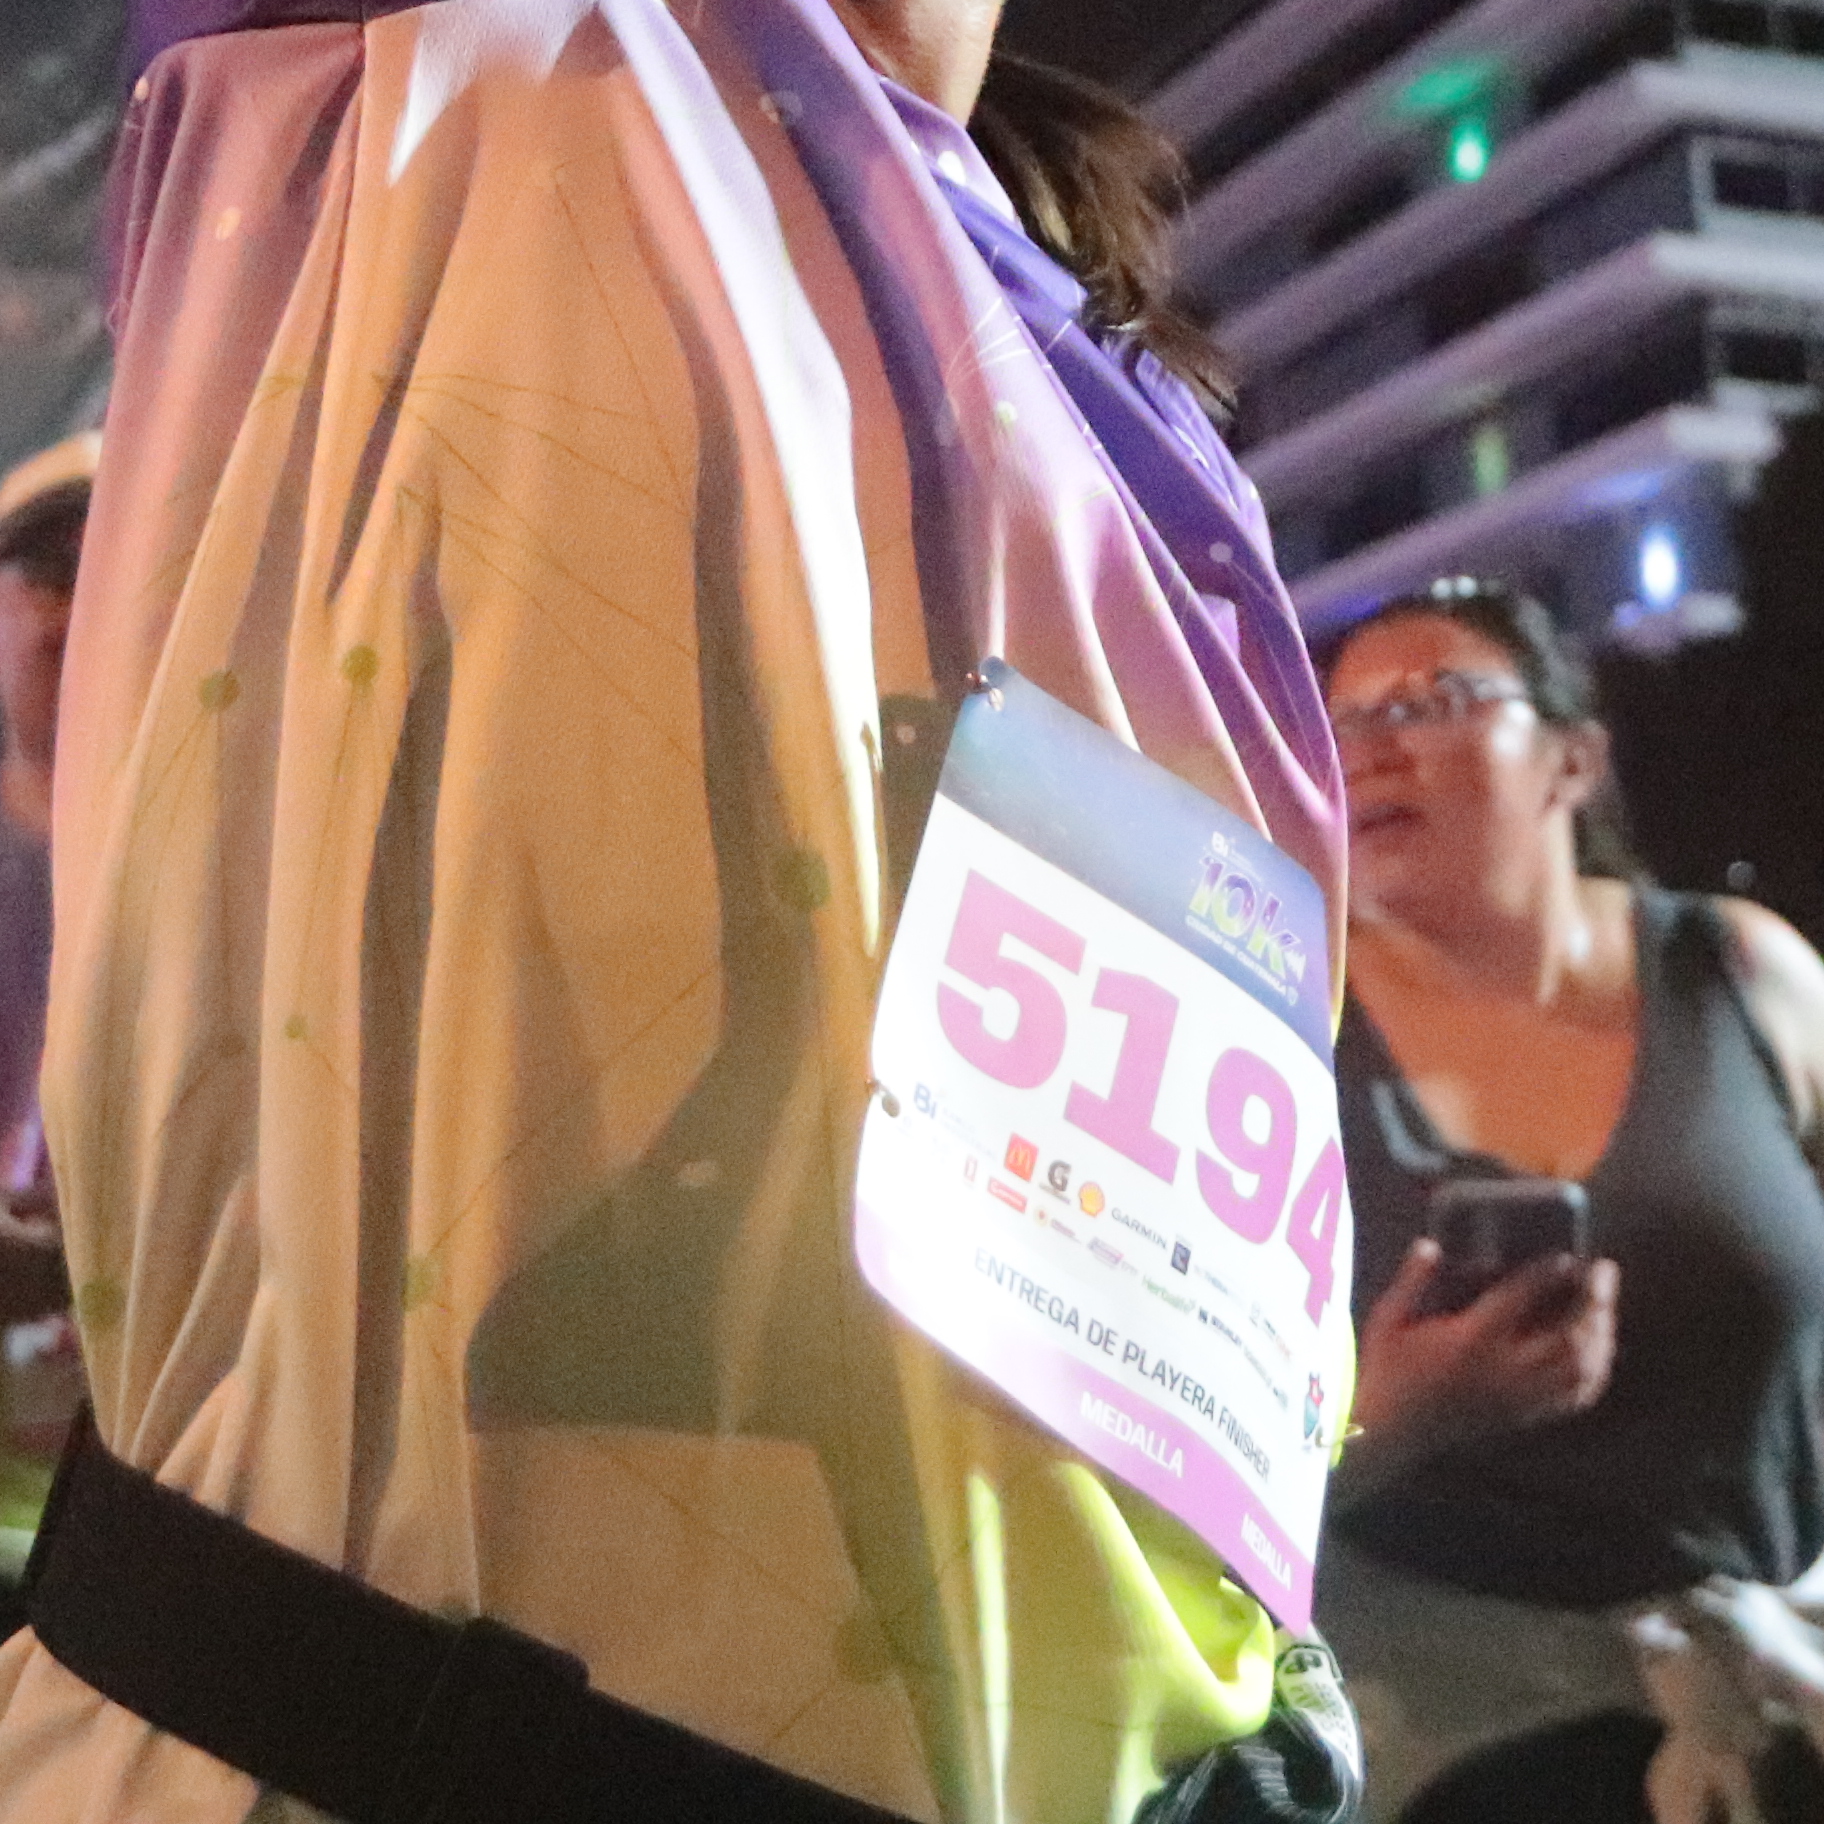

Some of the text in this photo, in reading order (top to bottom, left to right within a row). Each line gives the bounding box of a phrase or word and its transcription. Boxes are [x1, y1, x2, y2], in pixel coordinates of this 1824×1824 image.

[936, 868, 1347, 1329] 5194
[1111, 1207, 1168, 1251] GARMIN
[975, 1247, 1080, 1336] ENTREGA
[1087, 1317, 1119, 1356] DE
[1122, 1339, 1216, 1422] PLAYERA
[1218, 1405, 1271, 1483] FINISHER
[1080, 1389, 1185, 1478] MEDALLA
[1241, 1511, 1292, 1593] MEDALLA
